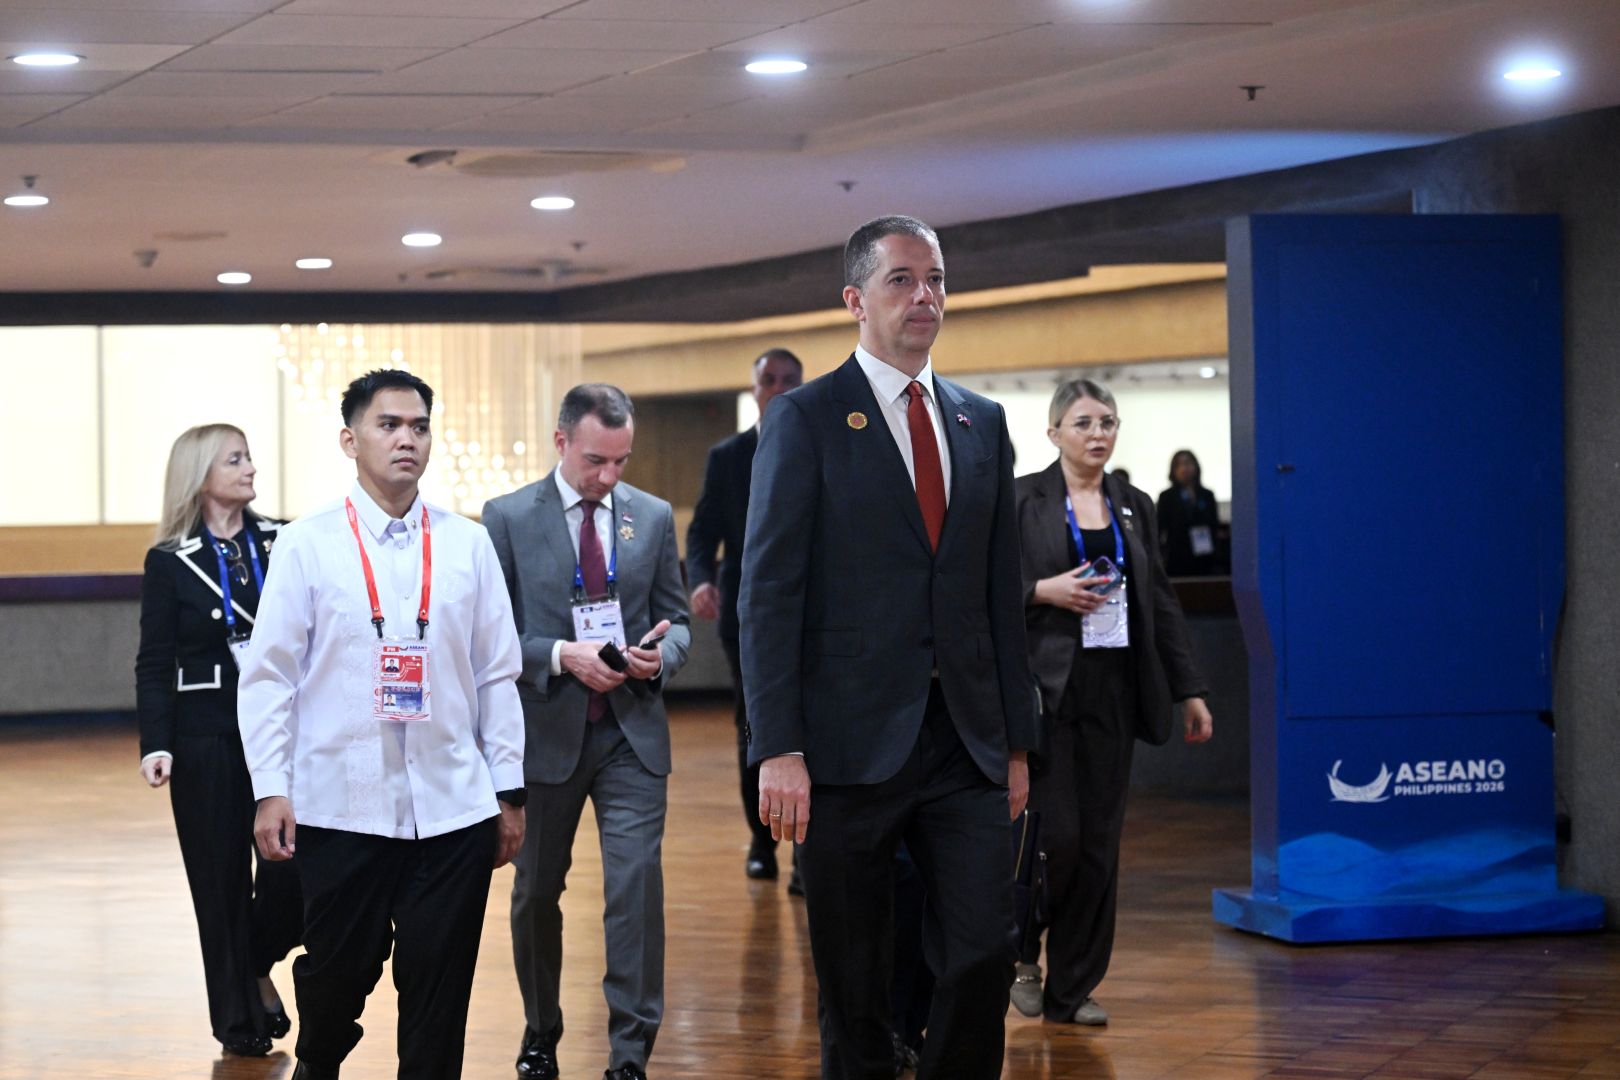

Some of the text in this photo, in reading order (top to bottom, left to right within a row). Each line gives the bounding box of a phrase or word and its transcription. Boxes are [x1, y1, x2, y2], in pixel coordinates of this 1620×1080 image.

[1395, 760, 1486, 783] ASEAN
[1394, 781, 1505, 796] PHILIPPINES 2026
